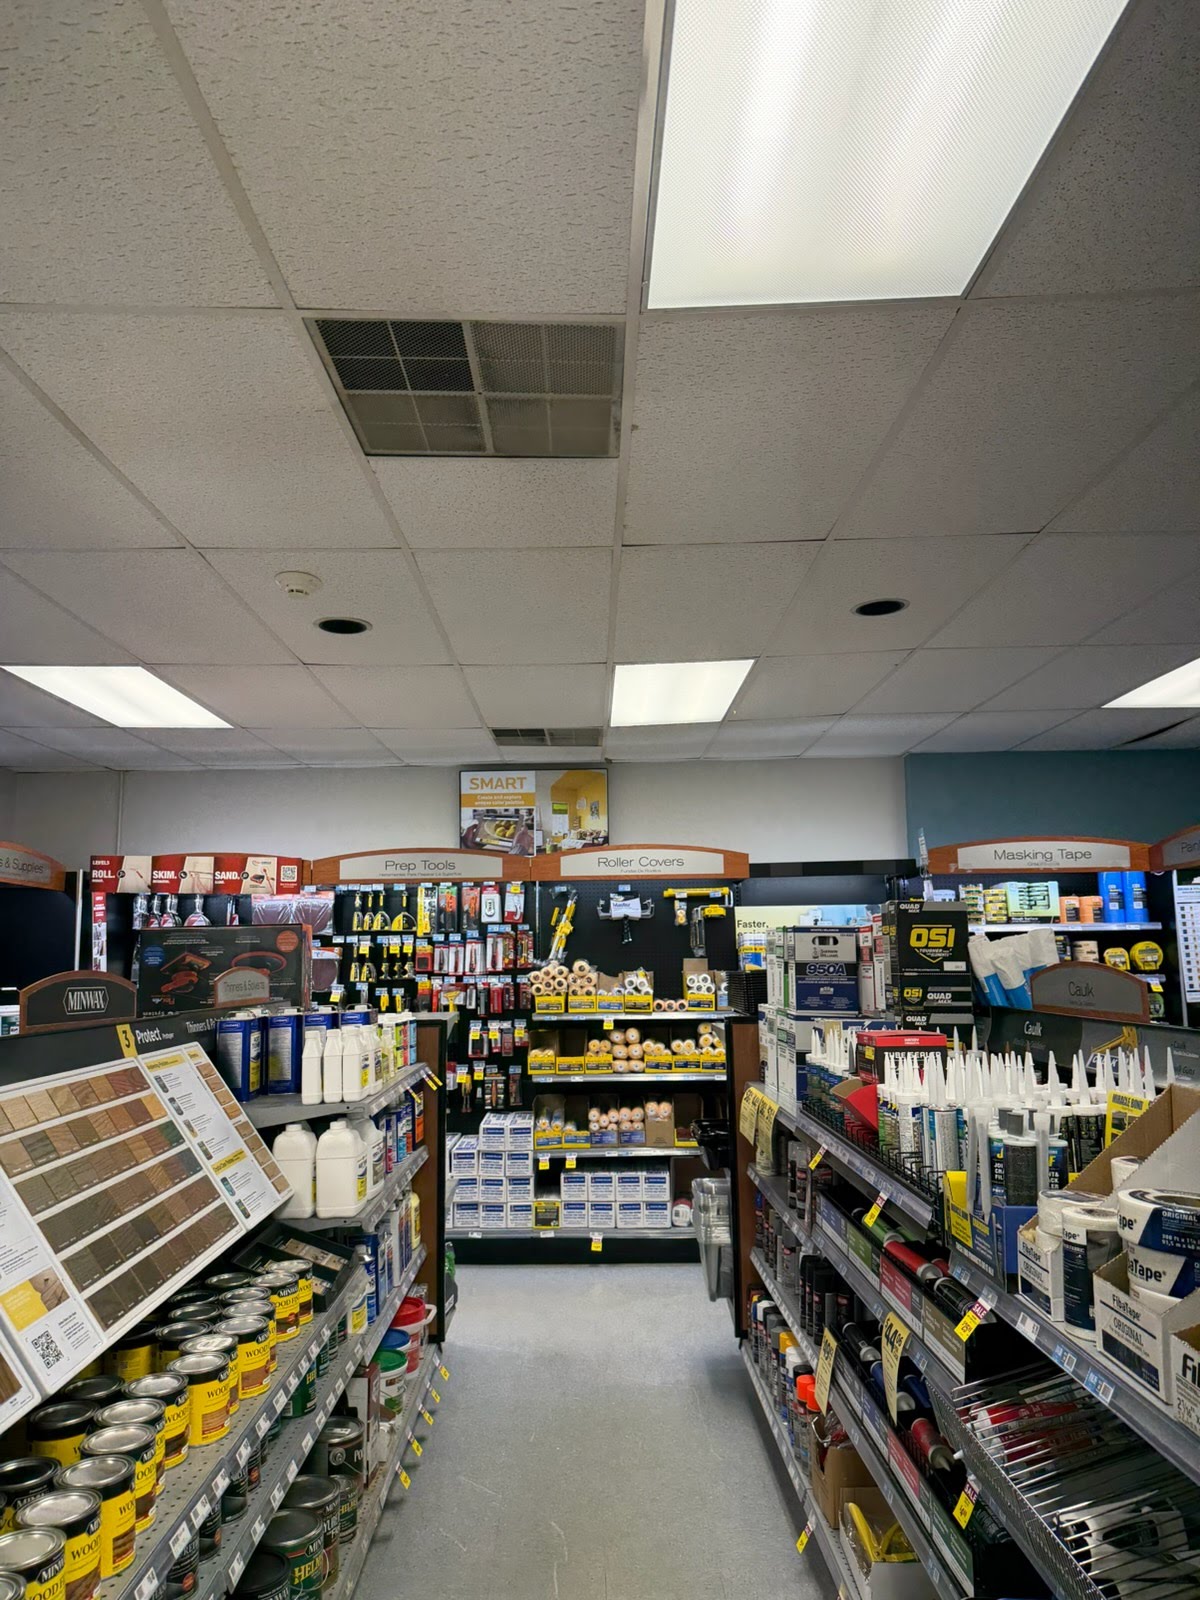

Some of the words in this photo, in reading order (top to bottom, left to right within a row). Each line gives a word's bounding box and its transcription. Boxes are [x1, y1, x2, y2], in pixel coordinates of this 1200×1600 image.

[469, 776, 527, 791] SMART
[597, 857, 635, 868] Roller
[638, 856, 685, 867] Covers
[994, 848, 1053, 861] Masking
[1057, 848, 1092, 861] Tape
[385, 859, 417, 872] Prep
[421, 859, 456, 871] Tools
[92, 870, 116, 878] ROLL.
[152, 871, 178, 879] SKIM.
[215, 871, 240, 880] SAND.
[909, 927, 956, 948] OSI
[806, 962, 847, 976] 950A
[903, 988, 923, 998] OSI
[927, 992, 953, 1000] QUAD
[1068, 981, 1095, 998] Caulk
[68, 990, 105, 1011] MINWAX
[186, 1021, 207, 1034] Thinners
[1024, 1021, 1042, 1037] Caulk
[122, 1030, 131, 1049] 3
[135, 1028, 163, 1045] Protect
[1162, 1210, 1198, 1222] ORIGINAL
[1128, 1258, 1163, 1283] aTape
[972, 1303, 988, 1319] SALE
[1112, 1294, 1142, 1321] FibaTape
[1113, 1317, 1145, 1347] ORIGINAL
[136, 1463, 156, 1481] OOD
[963, 1483, 978, 1504] SALE
